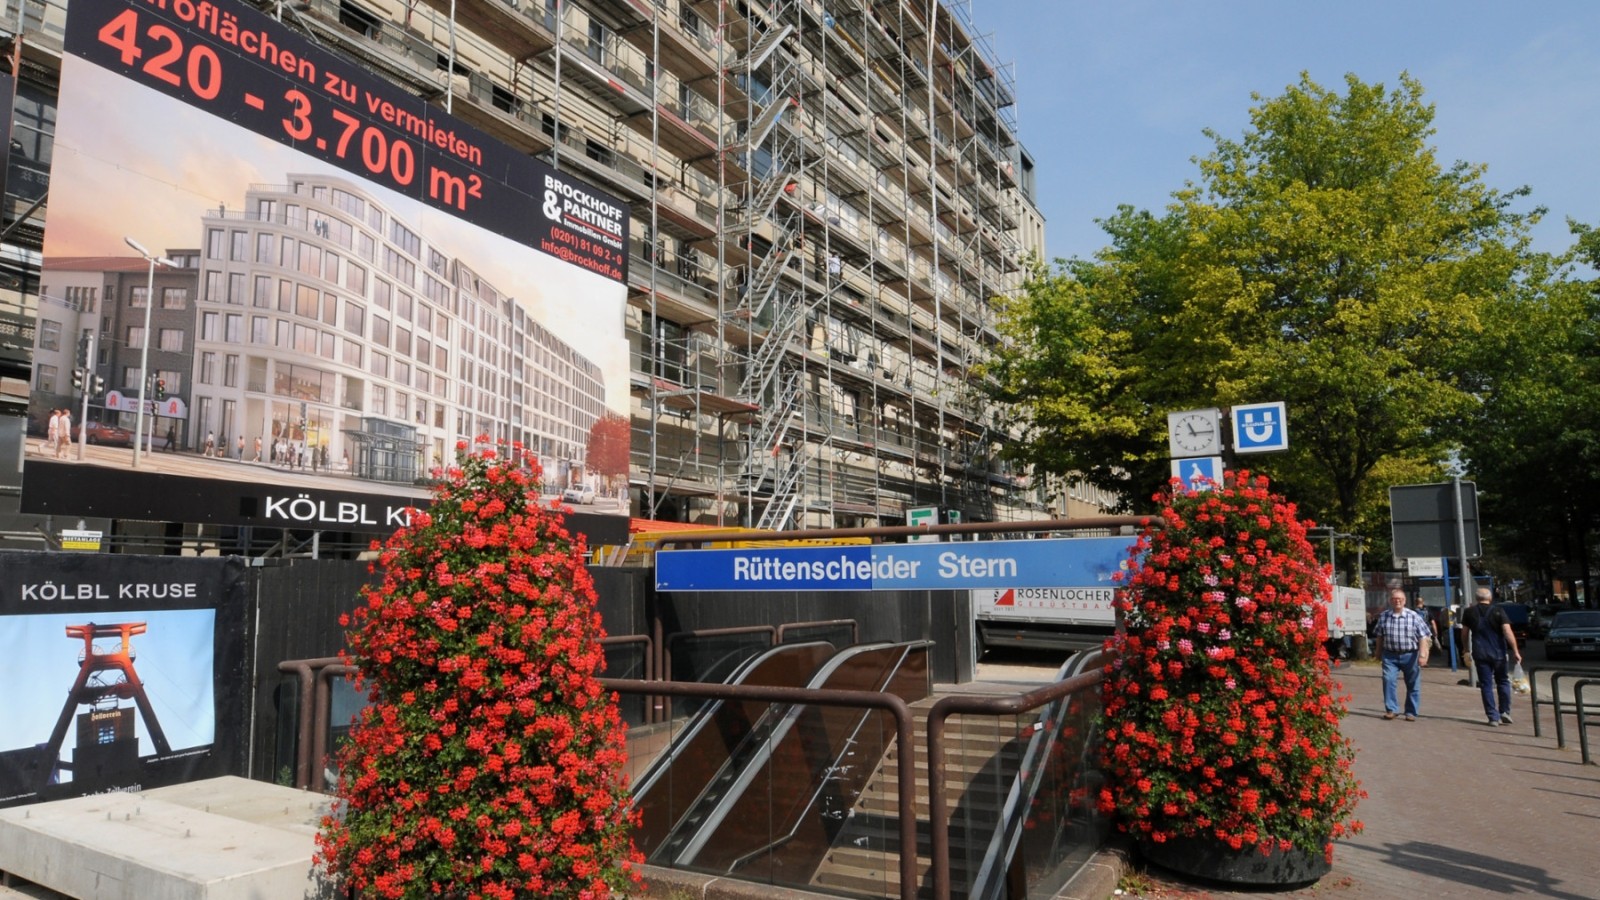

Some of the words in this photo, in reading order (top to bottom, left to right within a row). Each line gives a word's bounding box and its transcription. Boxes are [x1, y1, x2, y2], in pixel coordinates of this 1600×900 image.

[98, 9, 222, 100] 420
[245, 93, 265, 111] -
[282, 88, 415, 186] 3.700
[430, 165, 482, 211] m²
[324, 71, 357, 104] zu
[365, 91, 482, 166] vermieten
[542, 189, 562, 224] &
[564, 199, 622, 236] PARTNER
[545, 174, 622, 221] BROCKHOFF
[550, 226, 579, 250] (0201)
[580, 239, 591, 252] 81
[563, 217, 602, 241] Immobilien
[602, 235, 623, 250] GmbH
[541, 238, 623, 280] info@brockhoff.de
[265, 493, 378, 526] KÖLBL
[733, 554, 921, 581] Rüttenscheider
[938, 551, 1018, 579] Stern
[21, 580, 110, 600] KÖLBL
[119, 583, 197, 599] KRUSE
